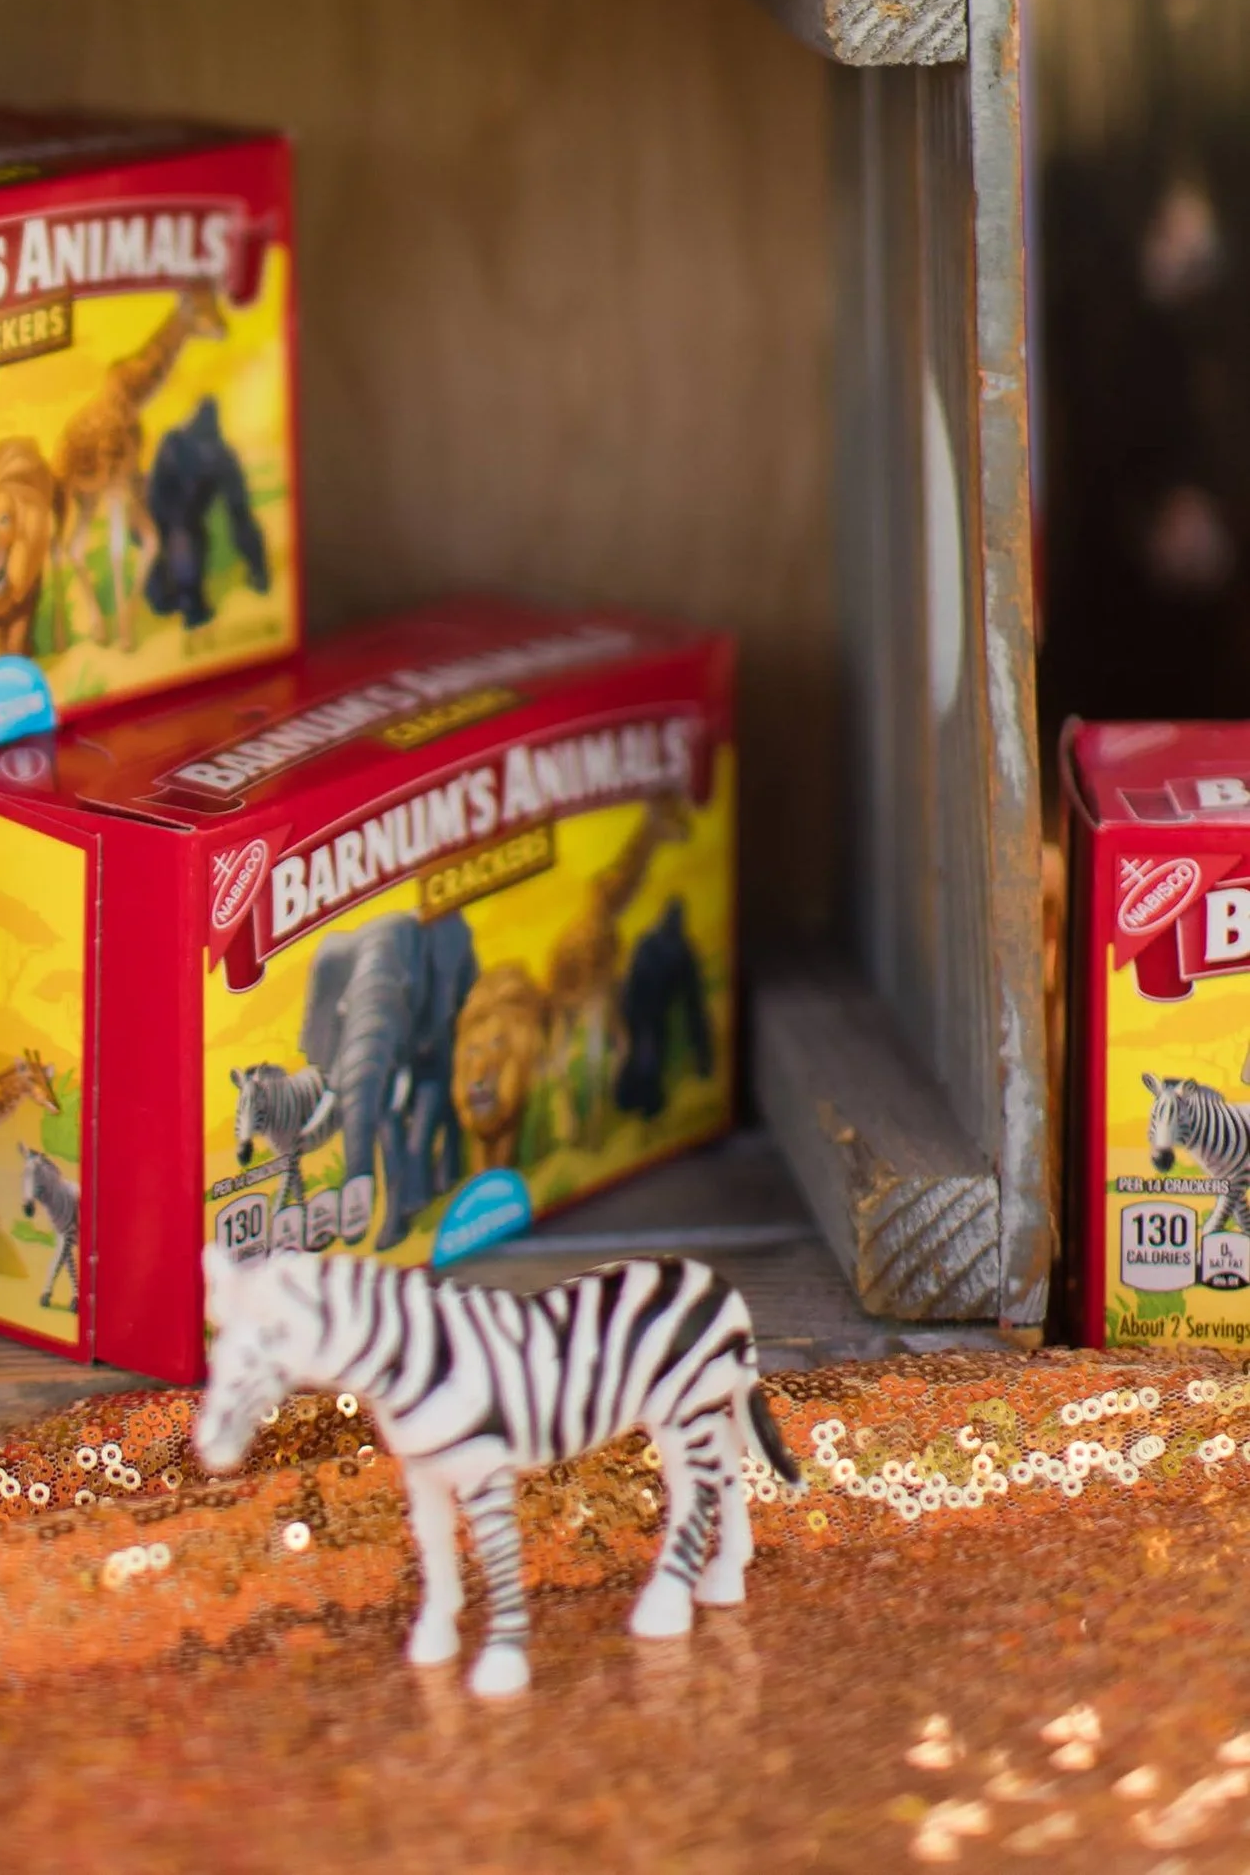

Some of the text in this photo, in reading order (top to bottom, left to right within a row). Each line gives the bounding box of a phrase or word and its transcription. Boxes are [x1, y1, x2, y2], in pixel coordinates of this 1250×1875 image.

[15, 213, 230, 294] ANIMALS
[270, 766, 497, 940] BARNUM'S
[502, 717, 695, 822] ANIMALS
[216, 845, 265, 923] NABISCO
[426, 831, 550, 904] CRACKERS
[1125, 863, 1194, 926] NABISCO
[1118, 1176, 1144, 1192] PER
[1164, 1178, 1230, 1195] CRACKERS
[224, 1203, 262, 1248] 130
[1133, 1212, 1189, 1248] 130
[1126, 1250, 1192, 1265] CALORIES
[1119, 1313, 1166, 1338] About
[1171, 1315, 1181, 1337] 2
